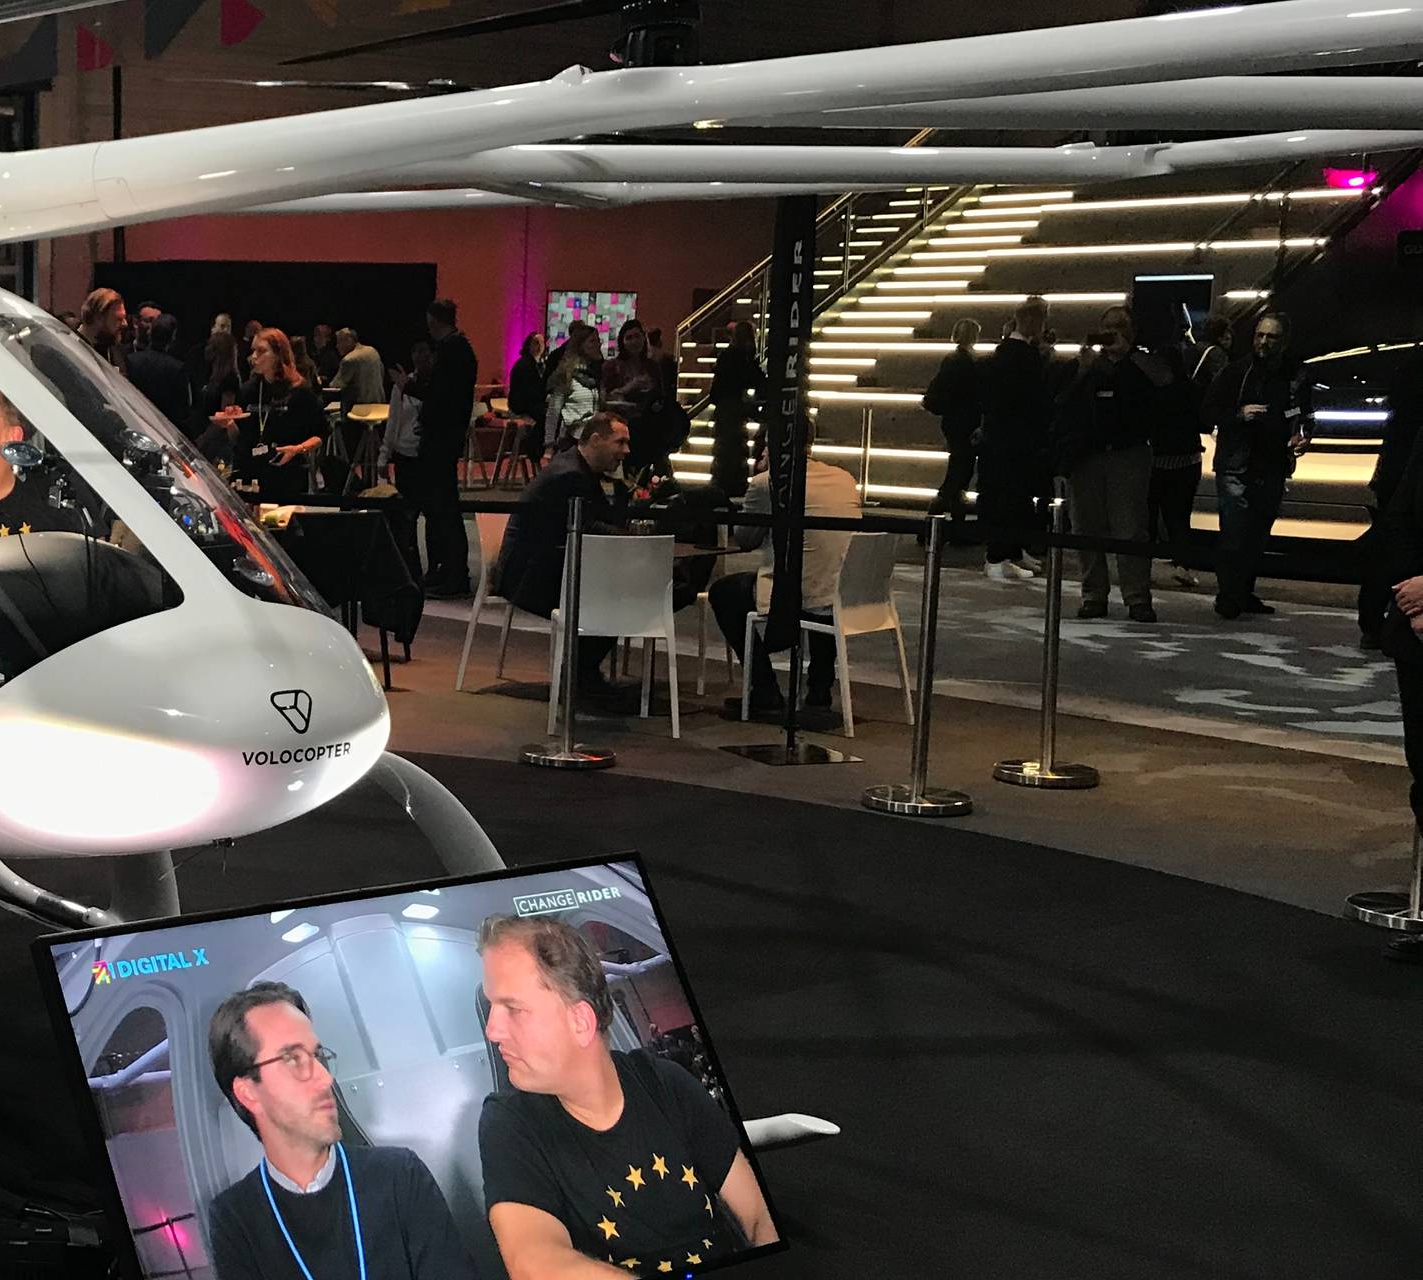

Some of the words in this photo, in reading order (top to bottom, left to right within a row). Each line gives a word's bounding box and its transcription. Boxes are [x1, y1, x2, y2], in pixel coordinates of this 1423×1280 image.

[785, 240, 803, 379] RIDER
[242, 742, 351, 766] VOLOCOPTER
[519, 893, 574, 912] CHANGE
[576, 886, 621, 904] RIDER
[117, 951, 193, 978] DIGITAL
[192, 948, 209, 967] X
